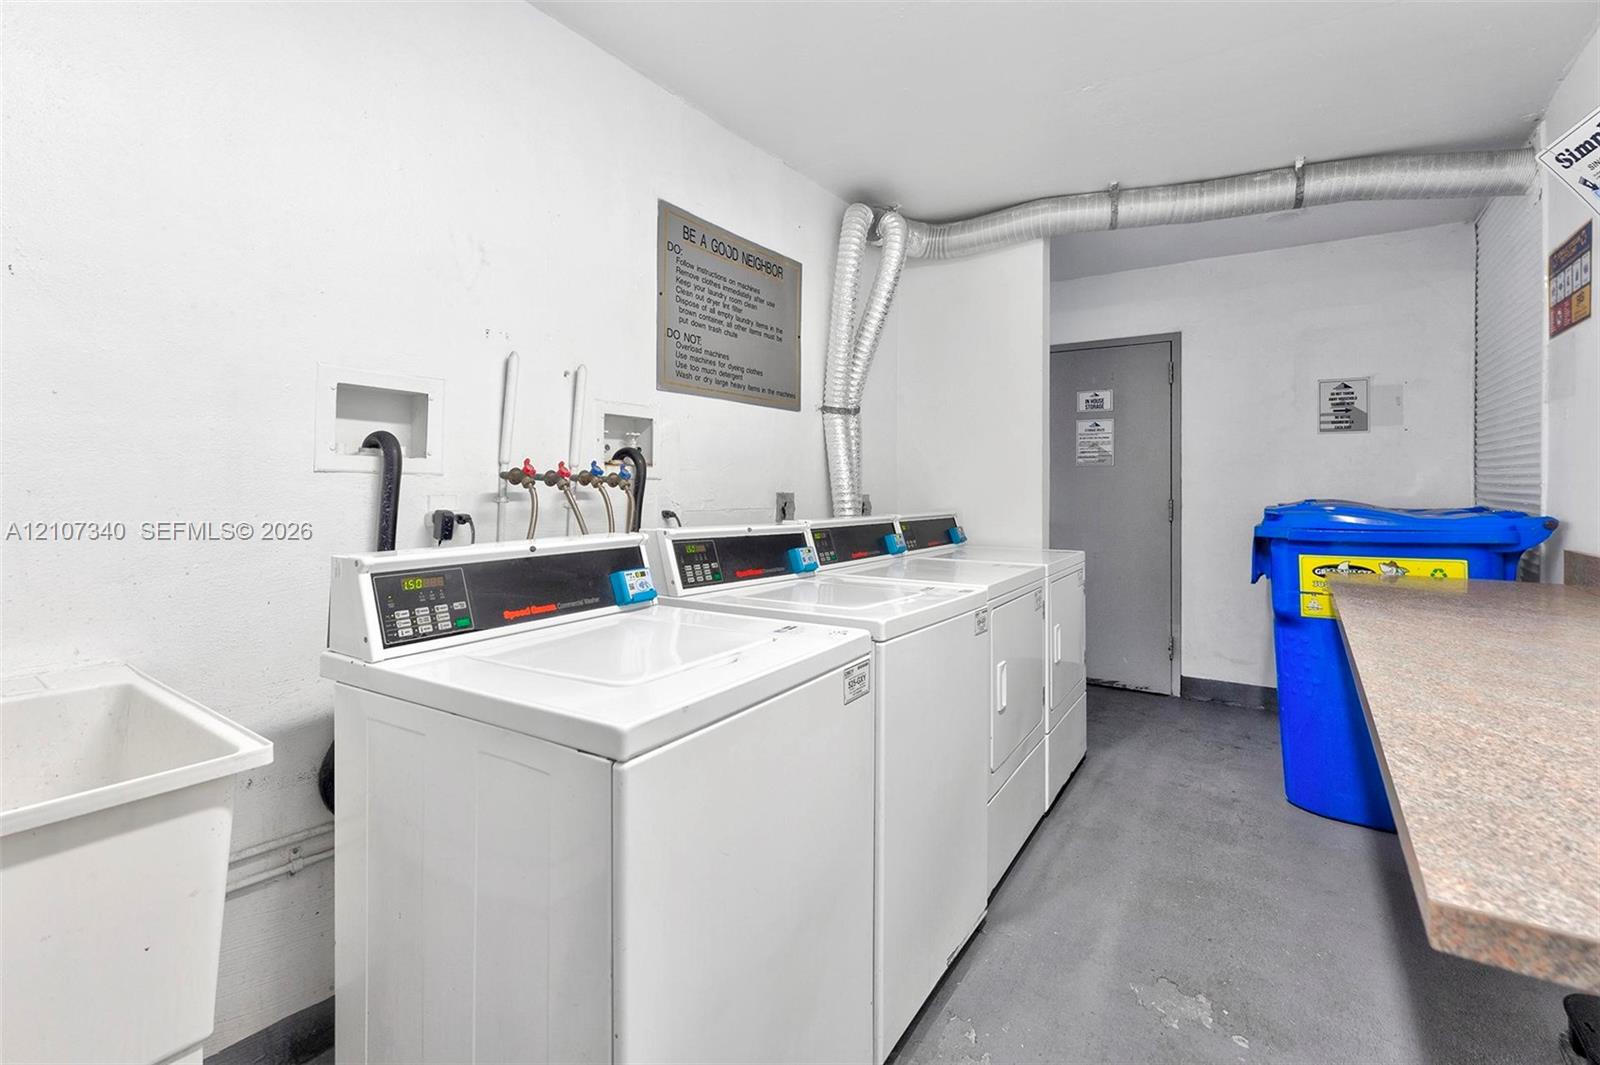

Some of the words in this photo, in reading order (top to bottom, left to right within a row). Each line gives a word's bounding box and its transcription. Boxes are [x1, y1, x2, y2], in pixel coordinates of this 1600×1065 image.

[667, 240, 683, 256] DO:
[683, 225, 696, 244] BE
[700, 233, 707, 249] A
[711, 238, 739, 261] GOOD
[742, 251, 784, 280] NEIGHBOR
[676, 256, 694, 270] Follow
[696, 265, 727, 282] instructions
[728, 278, 736, 286] on
[737, 281, 761, 295] machines
[676, 266, 700, 282] Remove
[701, 277, 721, 290] clothes
[722, 284, 752, 301] immediately
[754, 296, 765, 305] after
[766, 301, 776, 309] use
[676, 275, 692, 288] Keep
[693, 283, 705, 293] your
[707, 287, 728, 301] laundry
[728, 296, 743, 306] room
[743, 301, 758, 311] clean
[676, 285, 693, 298] Clean
[695, 293, 705, 302] out
[706, 297, 721, 307] dryer
[676, 295, 700, 310] Dispose
[701, 304, 708, 312] of
[717, 310, 734, 321] empty
[735, 313, 754, 328] laundry
[755, 321, 769, 331] items
[776, 327, 784, 335] the
[679, 305, 698, 318] brown
[734, 323, 748, 332] other
[749, 327, 762, 337] items
[763, 332, 775, 341] must
[776, 335, 783, 343] be
[679, 316, 689, 325] put
[690, 319, 707, 330] down
[708, 325, 722, 335] trash
[723, 329, 738, 339] chute
[667, 327, 681, 340] DO
[676, 340, 703, 355] Overload
[704, 349, 730, 361] machines
[676, 350, 688, 361] Use
[689, 355, 717, 367] machines
[718, 360, 726, 369] for
[727, 363, 745, 375] dyeing
[746, 367, 764, 377] clothes
[675, 369, 694, 381] Wash
[703, 375, 713, 386] dry
[715, 377, 729, 388] large
[730, 380, 746, 391] heavy
[747, 384, 761, 393] items
[767, 388, 775, 396] the
[775, 390, 797, 400] machines
[676, 360, 688, 370] Use
[690, 364, 700, 372] too
[701, 367, 717, 376] much
[718, 370, 744, 382] detergent
